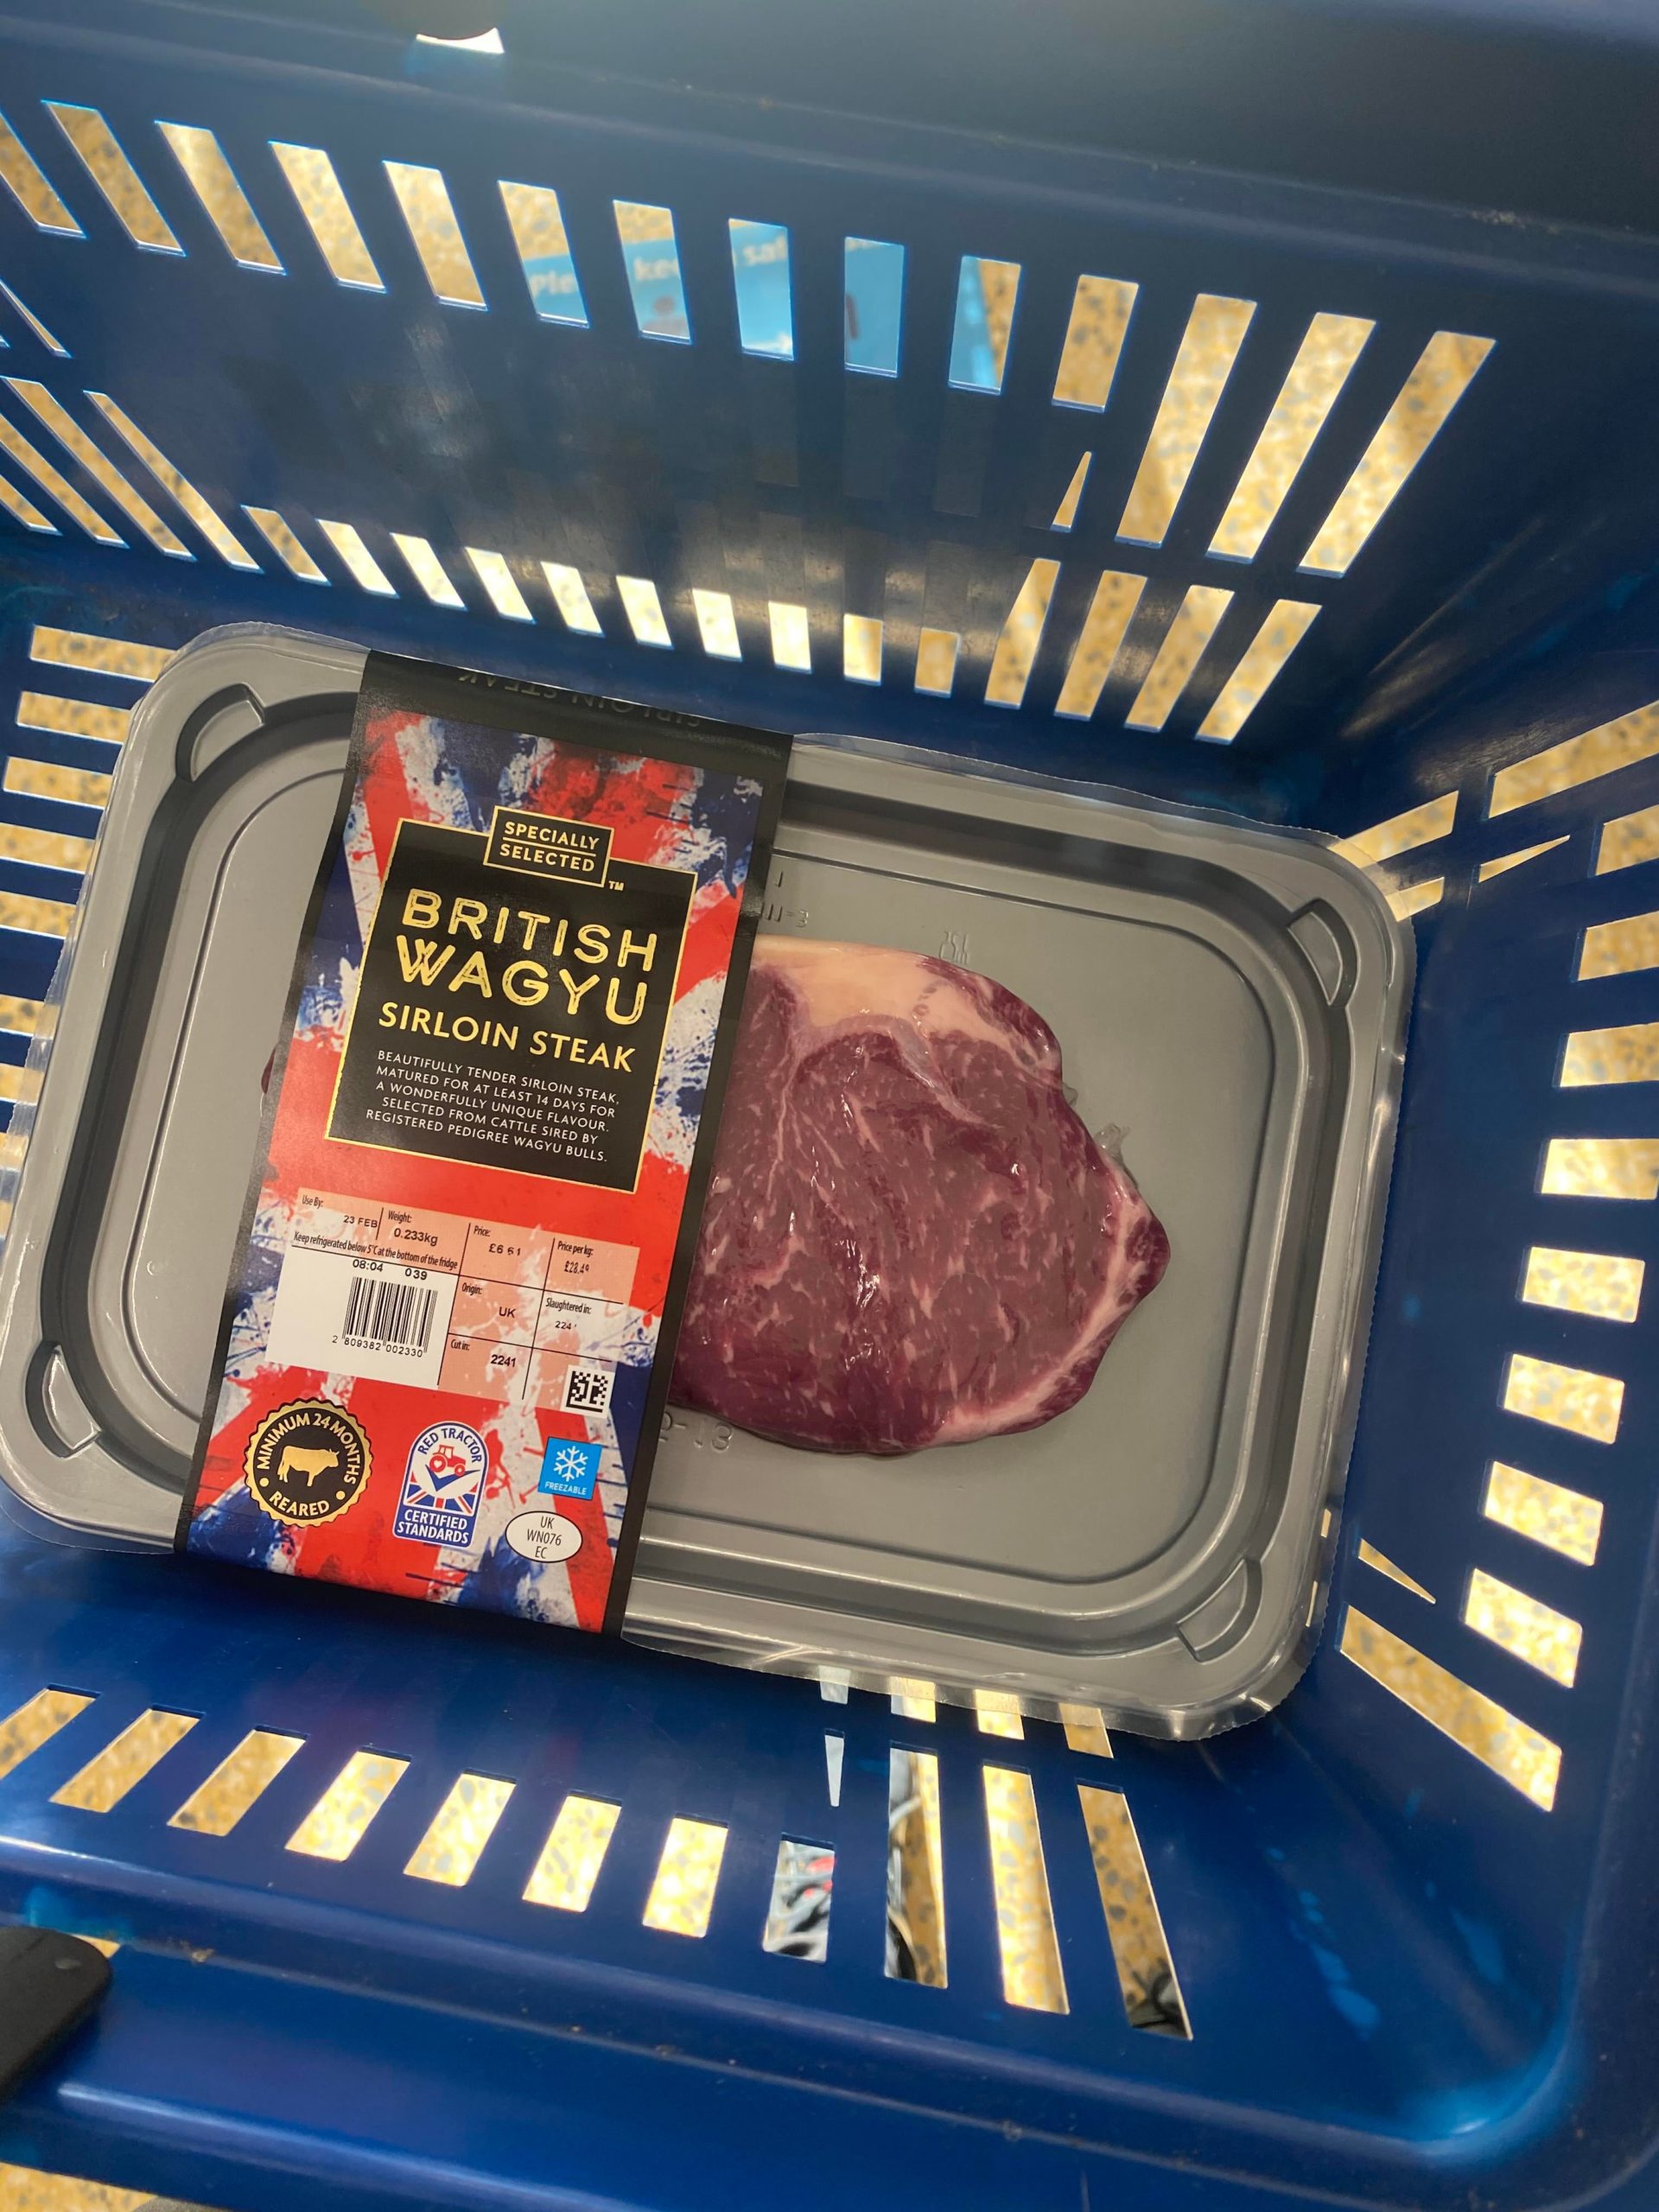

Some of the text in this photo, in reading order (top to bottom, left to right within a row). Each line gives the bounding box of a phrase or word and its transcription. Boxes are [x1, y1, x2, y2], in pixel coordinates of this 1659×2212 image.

[504, 821, 600, 850] SPECIALLY
[499, 843, 595, 872] SELECTED
[402, 888, 657, 972] BRITISH
[396, 934, 647, 1026] WAGYU
[378, 1001, 636, 1072] SIRLOIN STEAK
[378, 1050, 620, 1104] BEAUTIFULLY TENDER SIRLOIN STEAK,
[376, 1065, 615, 1118] MATURED FOR AT LEAST 14 DAYS FOR
[376, 1081, 609, 1132] A WONDERFULLY UNIQUE FLAVOUR.
[382, 1096, 598, 1145] SELECTED FROM CATTLE SIRED BY
[365, 1109, 607, 1162] REGISTERED PEDIGREE WAGYU BULLS.
[302, 1195, 324, 1209] Use By:
[343, 1215, 378, 1228] 23 FEB
[388, 1211, 411, 1224] Weight:
[393, 1228, 439, 1247] 0.233kg
[474, 1225, 491, 1237] Price:
[294, 1230, 309, 1245] Keep
[310, 1234, 347, 1249] refrigerated
[347, 1240, 366, 1253] below
[377, 1246, 385, 1256] at
[385, 1247, 396, 1258] the
[397, 1249, 419, 1262] bottom
[420, 1254, 428, 1263] of
[428, 1255, 439, 1266] the
[438, 1256, 457, 1270] fridge
[557, 1241, 594, 1257] Price per kg:
[353, 1259, 428, 1281] 08:04 039
[461, 1282, 482, 1295] Origin:
[499, 1306, 516, 1318] UK
[545, 1297, 583, 1313] Slaughtered
[332, 1335, 423, 1357] 2 809382 002330
[450, 1339, 470, 1351] Cut in:
[490, 1354, 516, 1367] 2241
[257, 1413, 360, 1484] MINIMUM 24 MONTHS
[417, 1427, 482, 1463] RED TRACTOR
[544, 1481, 588, 1496] FREEZABLE
[269, 1491, 329, 1516] REARED
[404, 1510, 467, 1530] CERTIFIED
[540, 1516, 555, 1529] UK
[397, 1522, 469, 1544] STANDARDS
[527, 1529, 562, 1546] WN076
[535, 1545, 547, 1559] EC
